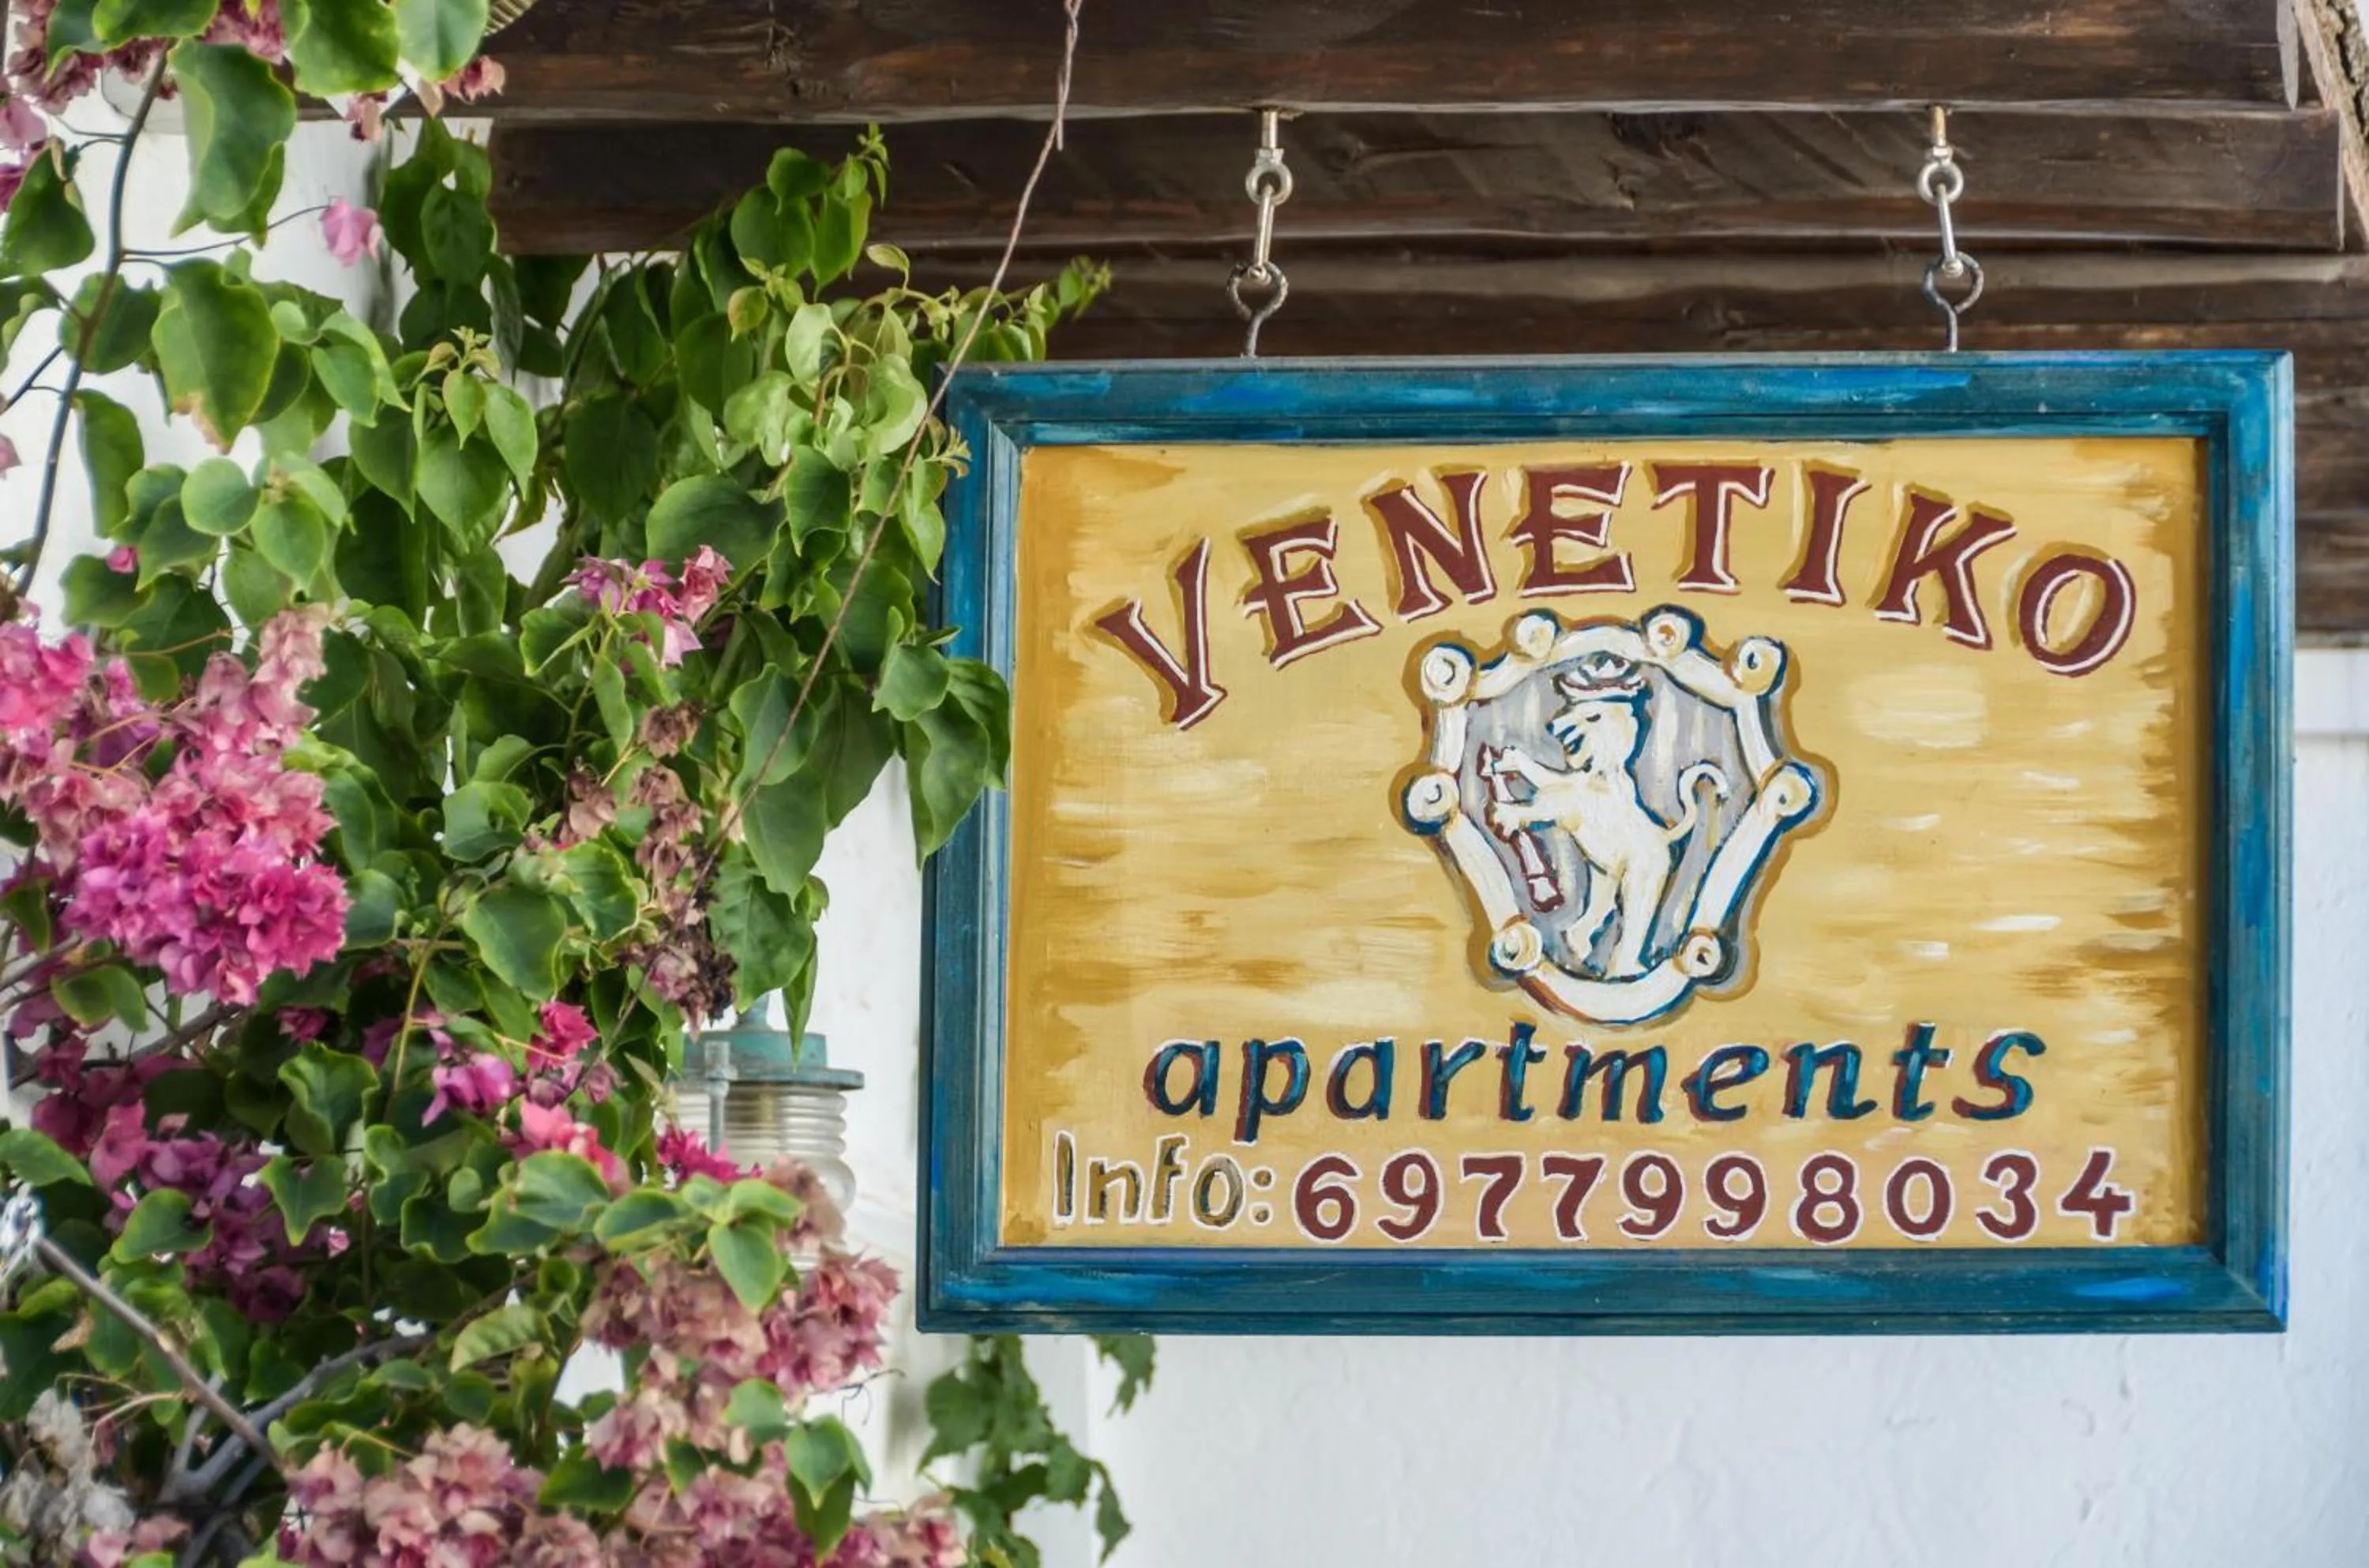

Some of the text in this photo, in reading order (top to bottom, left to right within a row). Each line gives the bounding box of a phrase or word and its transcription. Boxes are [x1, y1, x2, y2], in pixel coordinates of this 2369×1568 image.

[1094, 461, 2138, 730] VENETIKO
[1142, 1020, 2047, 1146] apartments
[1293, 1148, 2133, 1245] 6977998034
